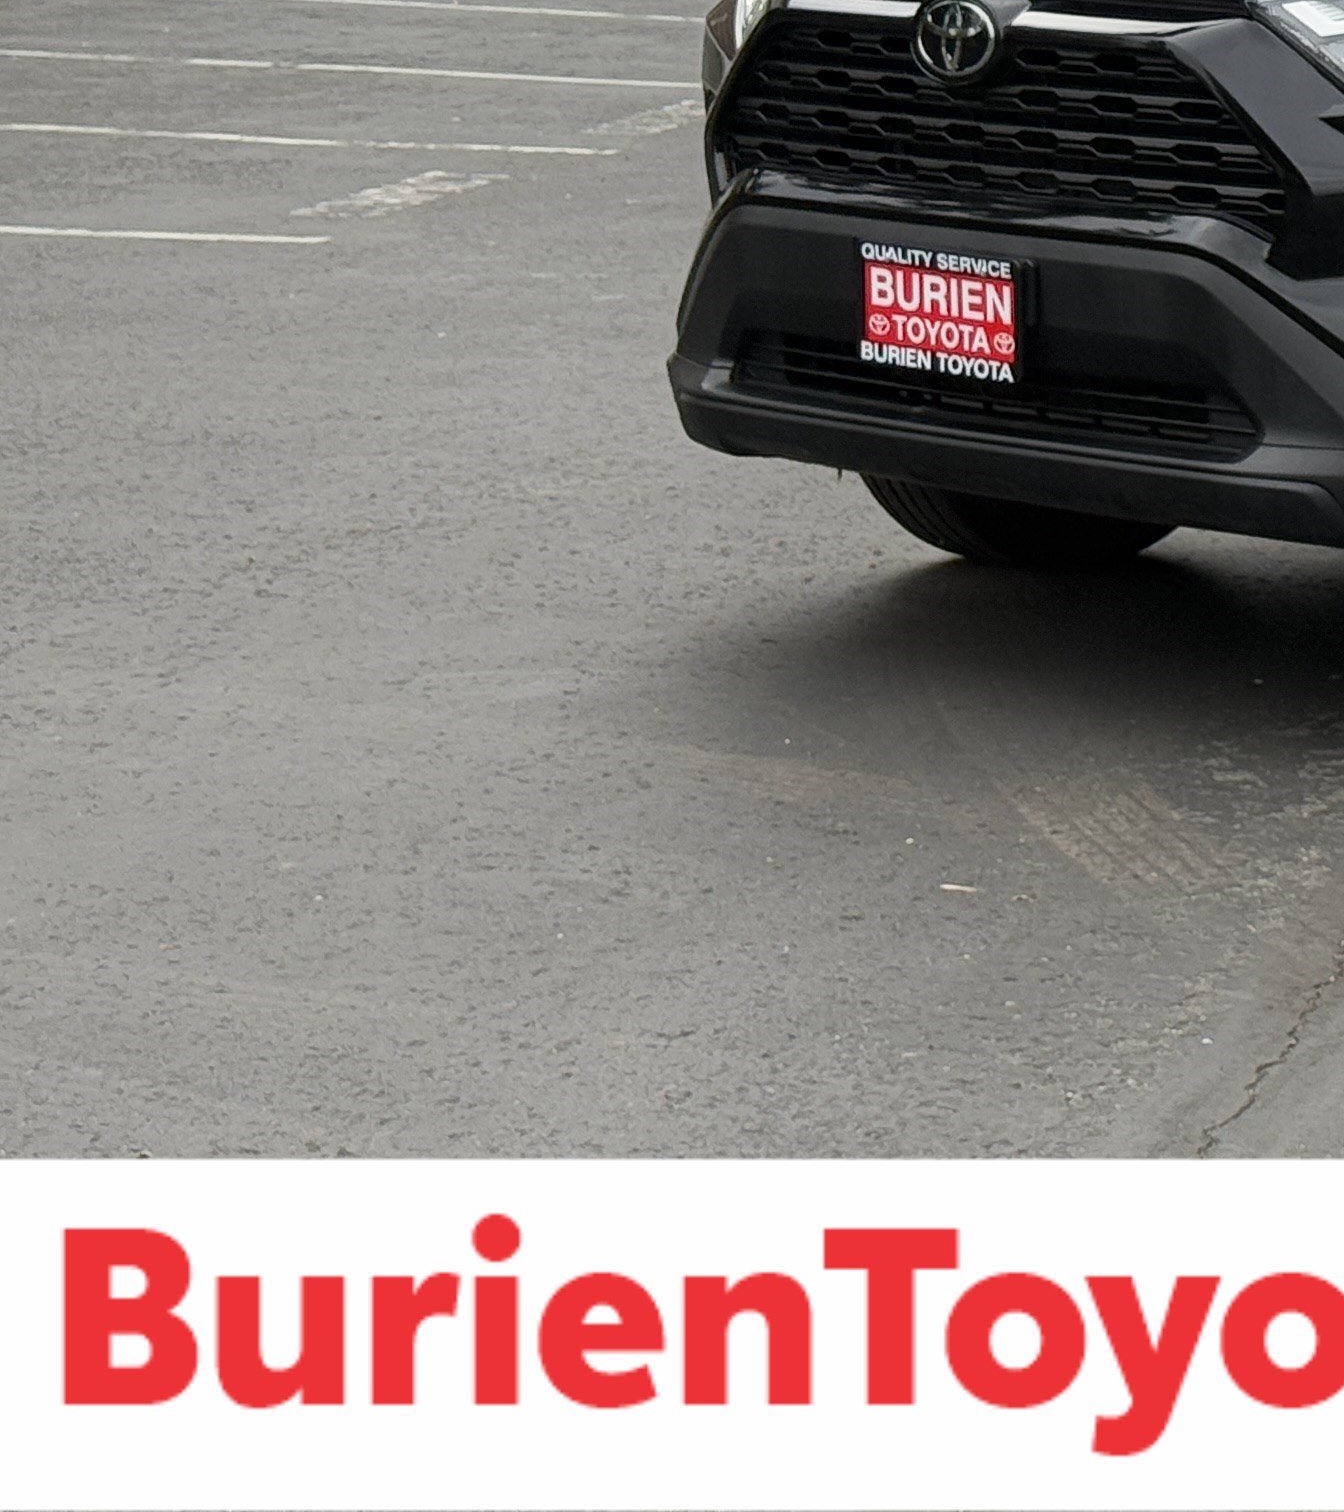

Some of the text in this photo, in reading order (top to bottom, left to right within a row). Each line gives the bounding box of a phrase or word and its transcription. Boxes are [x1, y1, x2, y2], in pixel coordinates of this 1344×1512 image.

[861, 242, 1012, 280] QUALITY SERVICE
[870, 266, 1012, 326] BURIEN
[891, 314, 992, 355] TOYOTA
[860, 340, 1015, 384] BURIEN TOYOTA
